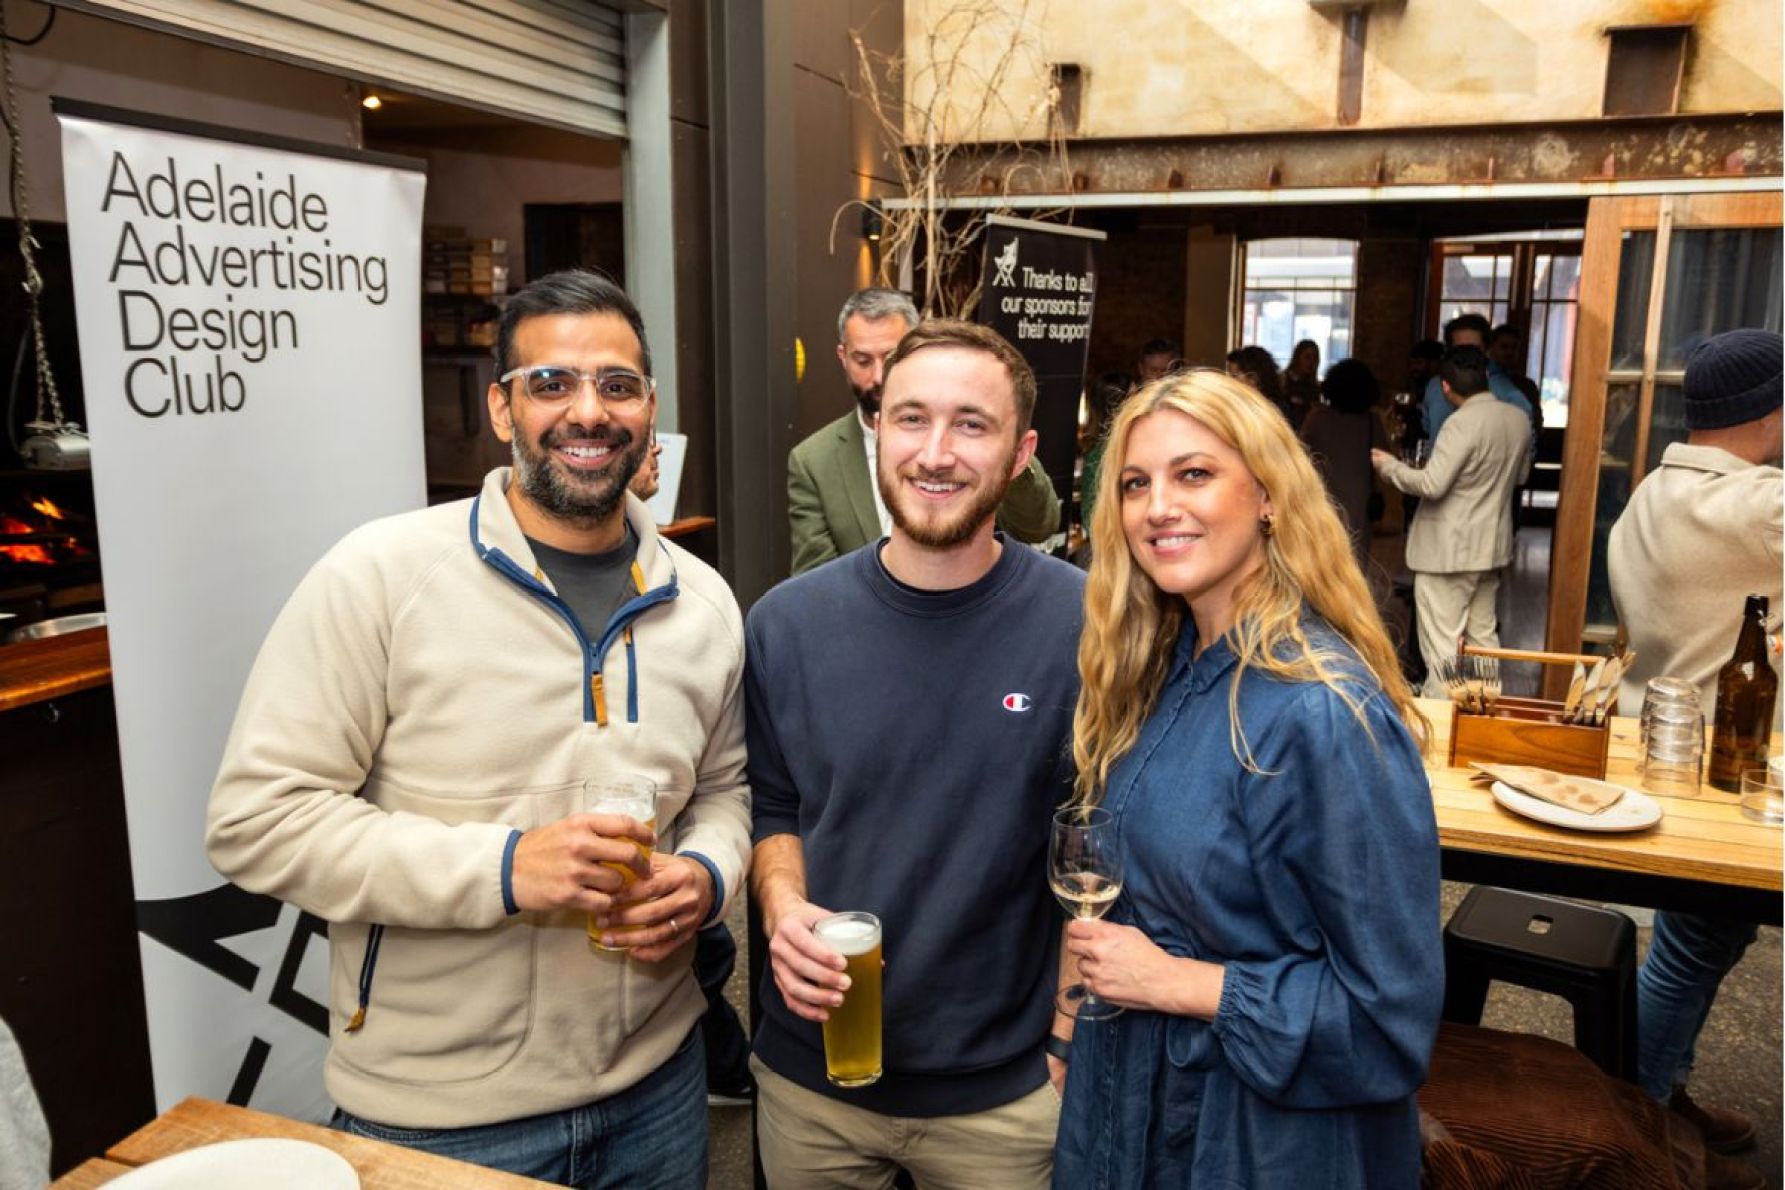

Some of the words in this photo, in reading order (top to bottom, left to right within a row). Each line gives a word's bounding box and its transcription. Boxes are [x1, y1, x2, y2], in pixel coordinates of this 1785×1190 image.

[100, 150, 328, 232] Adelaide
[108, 221, 388, 305] Advertising
[1022, 266, 1062, 290] Thanks
[1065, 272, 1078, 291] to
[1079, 272, 1093, 293] all
[118, 289, 298, 363] Design
[1001, 296, 1022, 313] our
[1024, 297, 1076, 317] sponsors
[1077, 295, 1092, 315] for
[1018, 318, 1046, 339] their
[124, 355, 246, 418] Club
